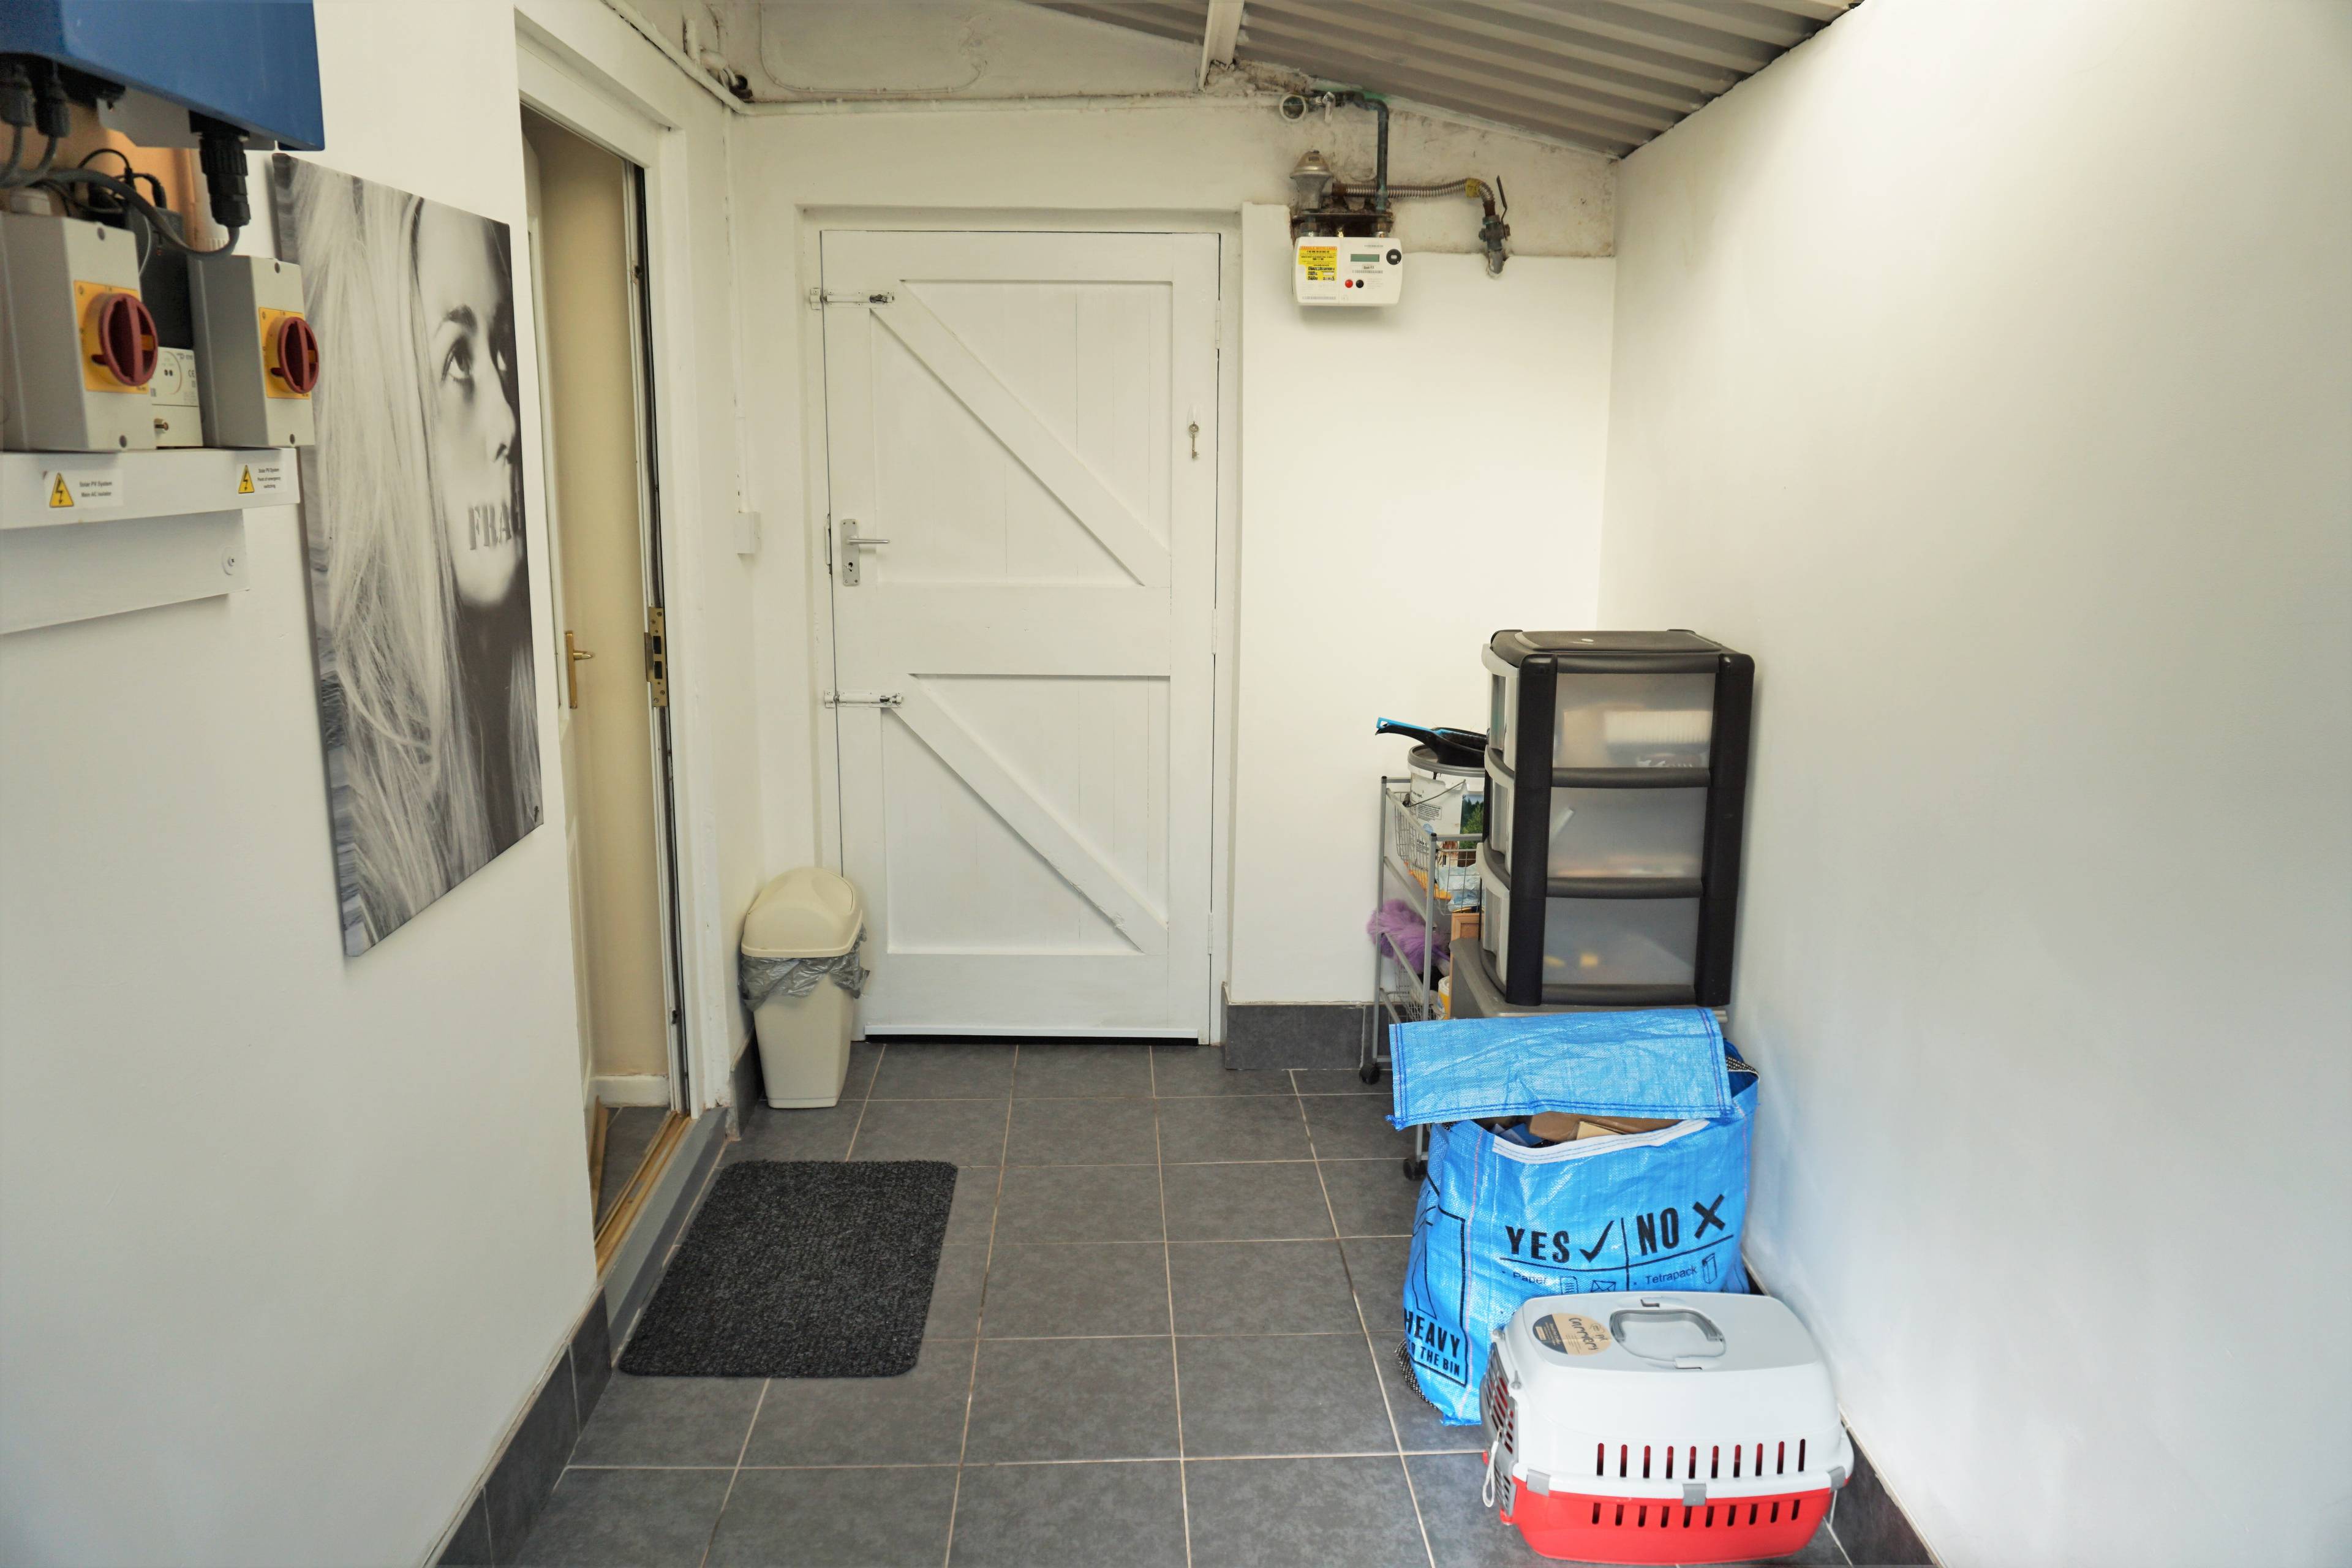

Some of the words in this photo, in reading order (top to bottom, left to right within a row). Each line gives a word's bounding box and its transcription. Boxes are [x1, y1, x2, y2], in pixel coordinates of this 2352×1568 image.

[1504, 1225, 1570, 1264] YES
[1636, 1207, 1679, 1256] NO
[1512, 1272, 1547, 1286] Paper
[1645, 1265, 1698, 1285] Tetrapack
[1404, 1307, 1461, 1359] HEAVY
[1420, 1346, 1440, 1366] THE
[1442, 1357, 1460, 1377] BIN
